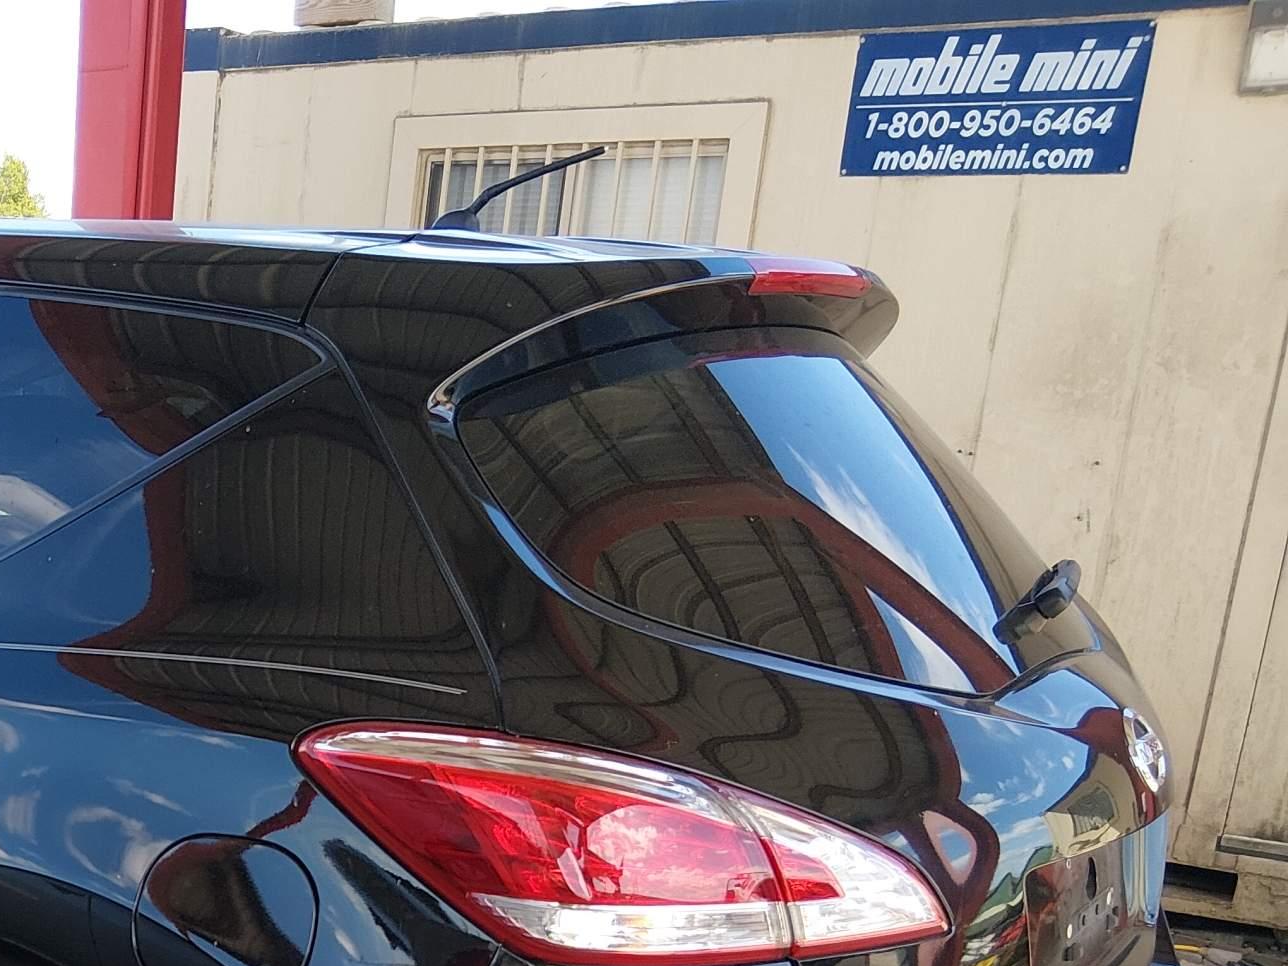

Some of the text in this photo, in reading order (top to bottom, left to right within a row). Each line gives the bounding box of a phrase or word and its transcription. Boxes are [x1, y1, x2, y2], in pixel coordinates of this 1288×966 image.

[859, 33, 1144, 97] mobile mini
[865, 105, 1117, 139] 1-800-950-6464
[872, 142, 1094, 171] mobilemini.com
